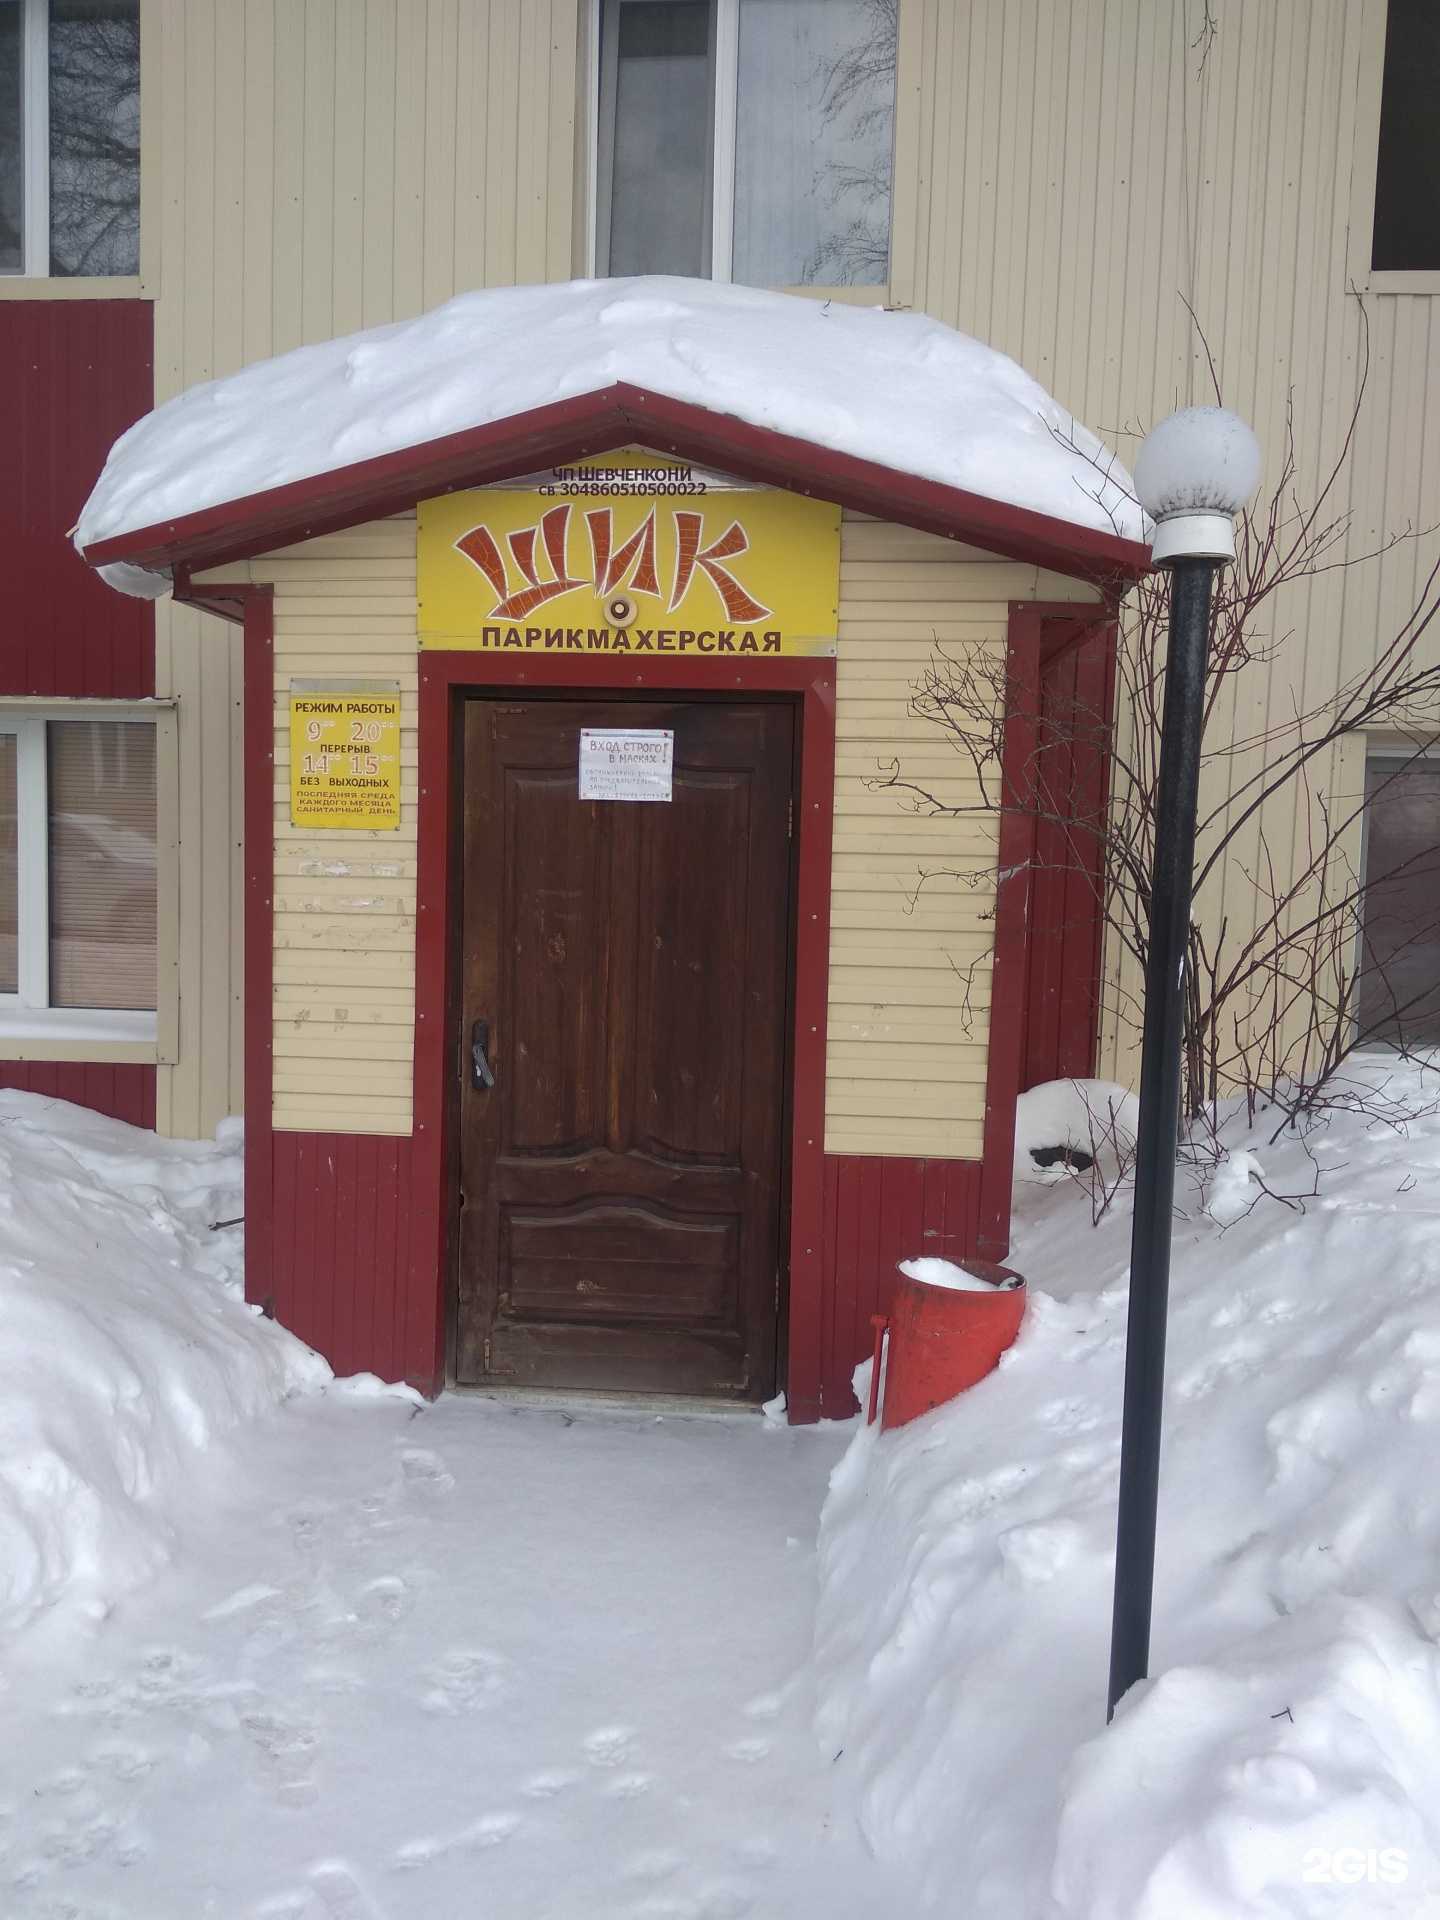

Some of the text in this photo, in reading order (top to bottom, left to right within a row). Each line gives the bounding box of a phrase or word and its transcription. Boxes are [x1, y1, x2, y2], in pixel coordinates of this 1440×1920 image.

[560, 482, 707, 497] 304860510500022
[452, 502, 775, 625] ШИК
[482, 626, 782, 653] ПАРИКМАХЕРСКАЯ
[295, 702, 395, 714] РЕЖИМ РАБОТЫ
[320, 744, 371, 754] ПЕРЕРЫВ
[590, 740, 620, 753] ВХОД
[609, 754, 615, 763] В
[300, 776, 390, 788] БЕЗ ВЫХОДНЫХ
[296, 791, 357, 799] ПОСЛЕДНЯЯ
[299, 799, 347, 807] КАЖДОГО
